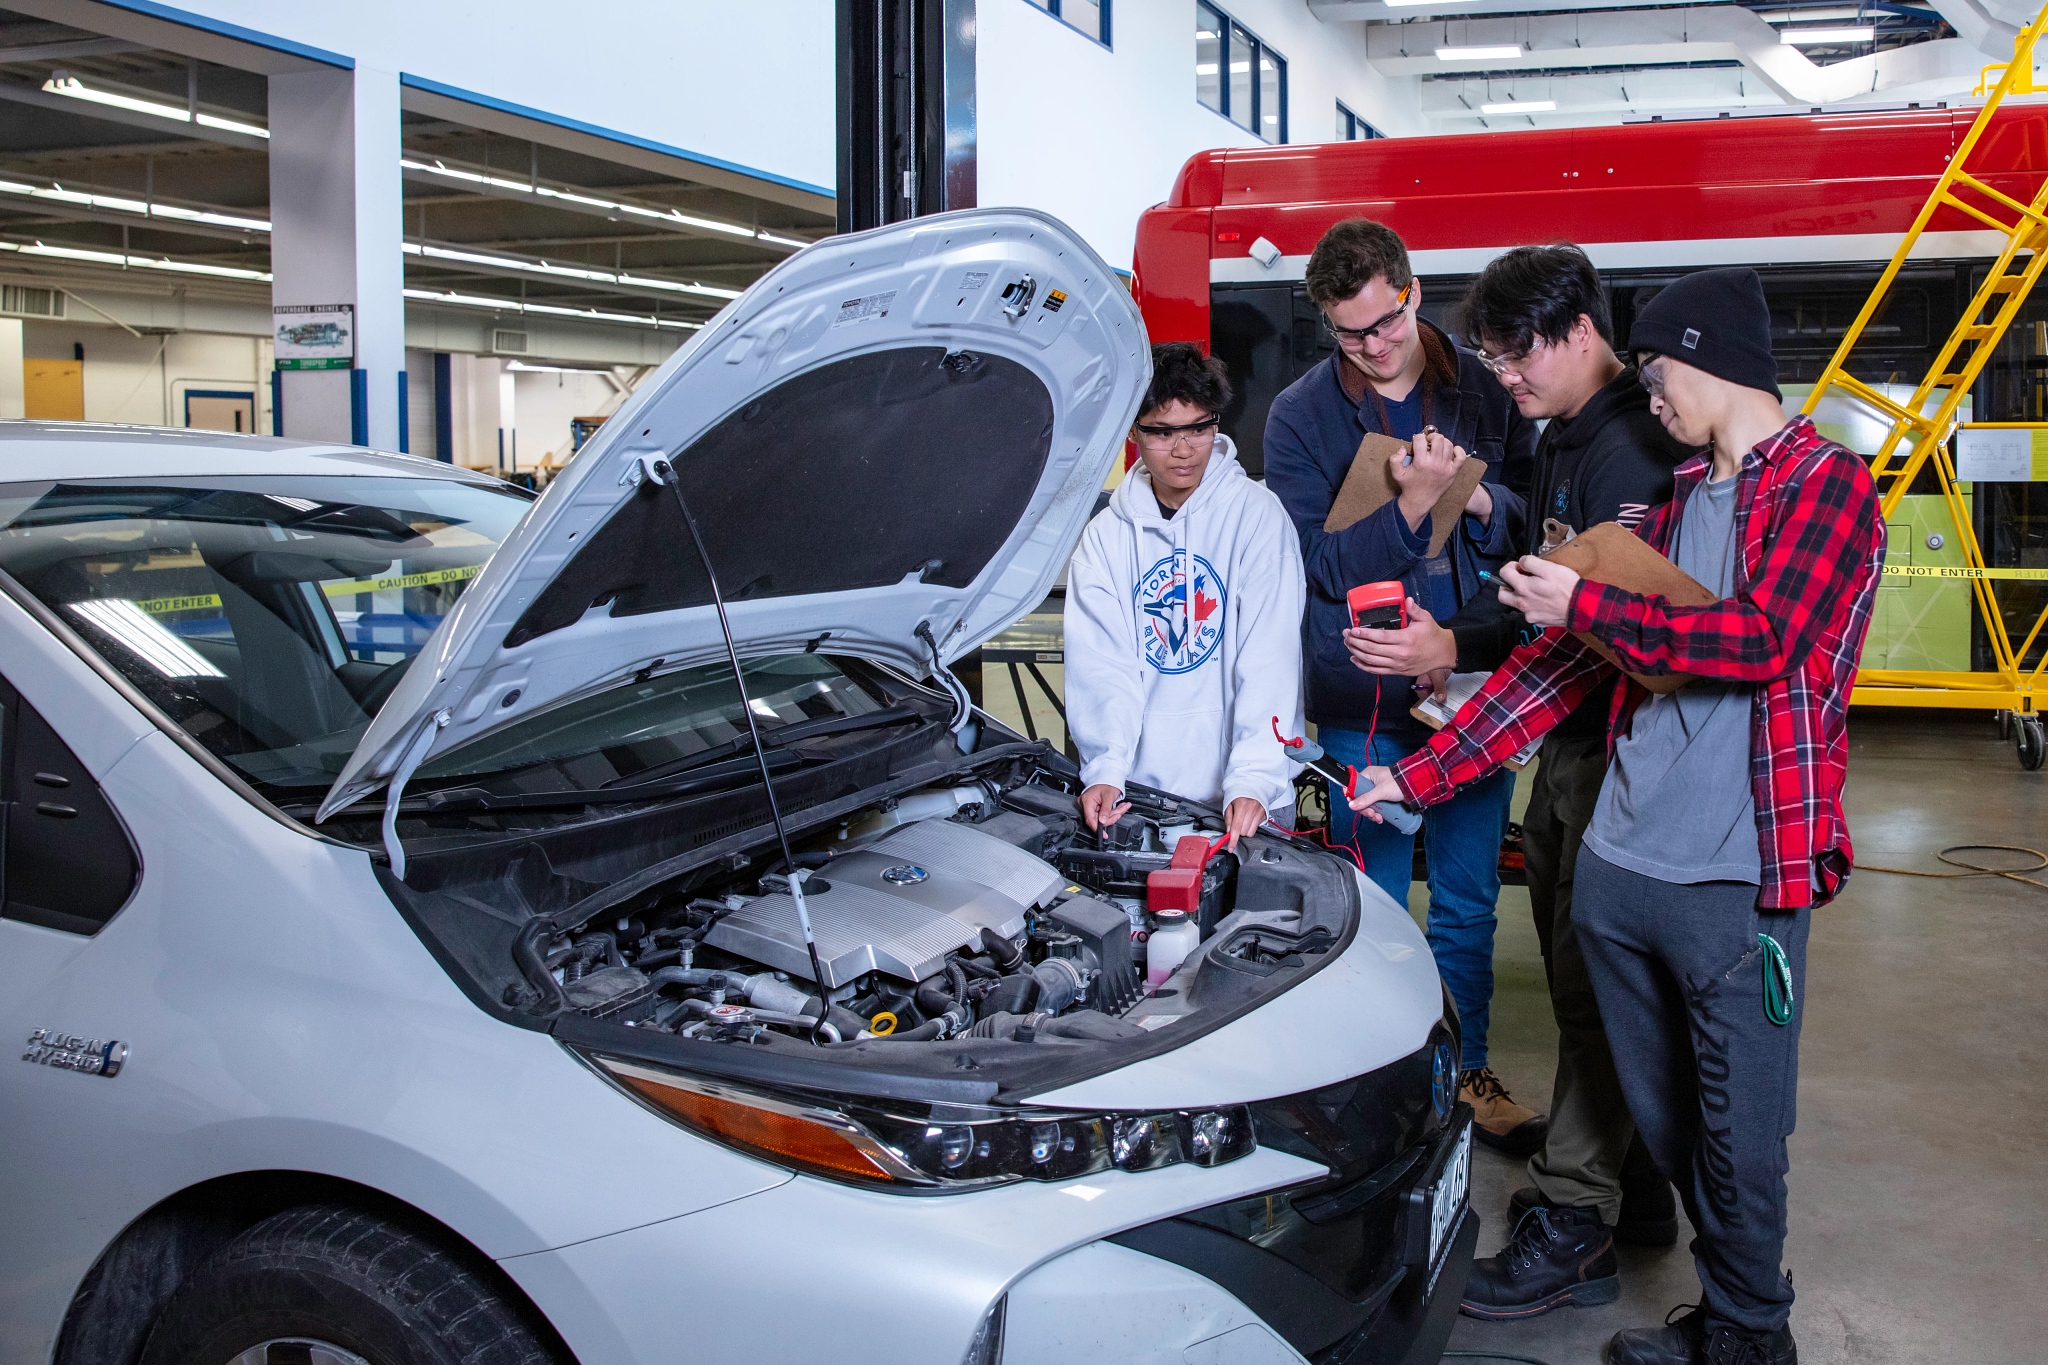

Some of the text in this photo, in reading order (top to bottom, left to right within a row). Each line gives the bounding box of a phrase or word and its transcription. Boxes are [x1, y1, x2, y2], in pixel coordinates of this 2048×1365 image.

[275, 305, 339, 314] DEPENDABLE ENGINES
[378, 574, 428, 589] CAUTION
[441, 570, 457, 581] DO
[1882, 566, 1983, 577] DO NOT ENTER
[144, 596, 212, 612] NOT ENTER
[28, 1027, 107, 1057] PLUG-IN
[21, 1045, 102, 1075] HYBRID
[1697, 1034, 1730, 1115] ZOO
